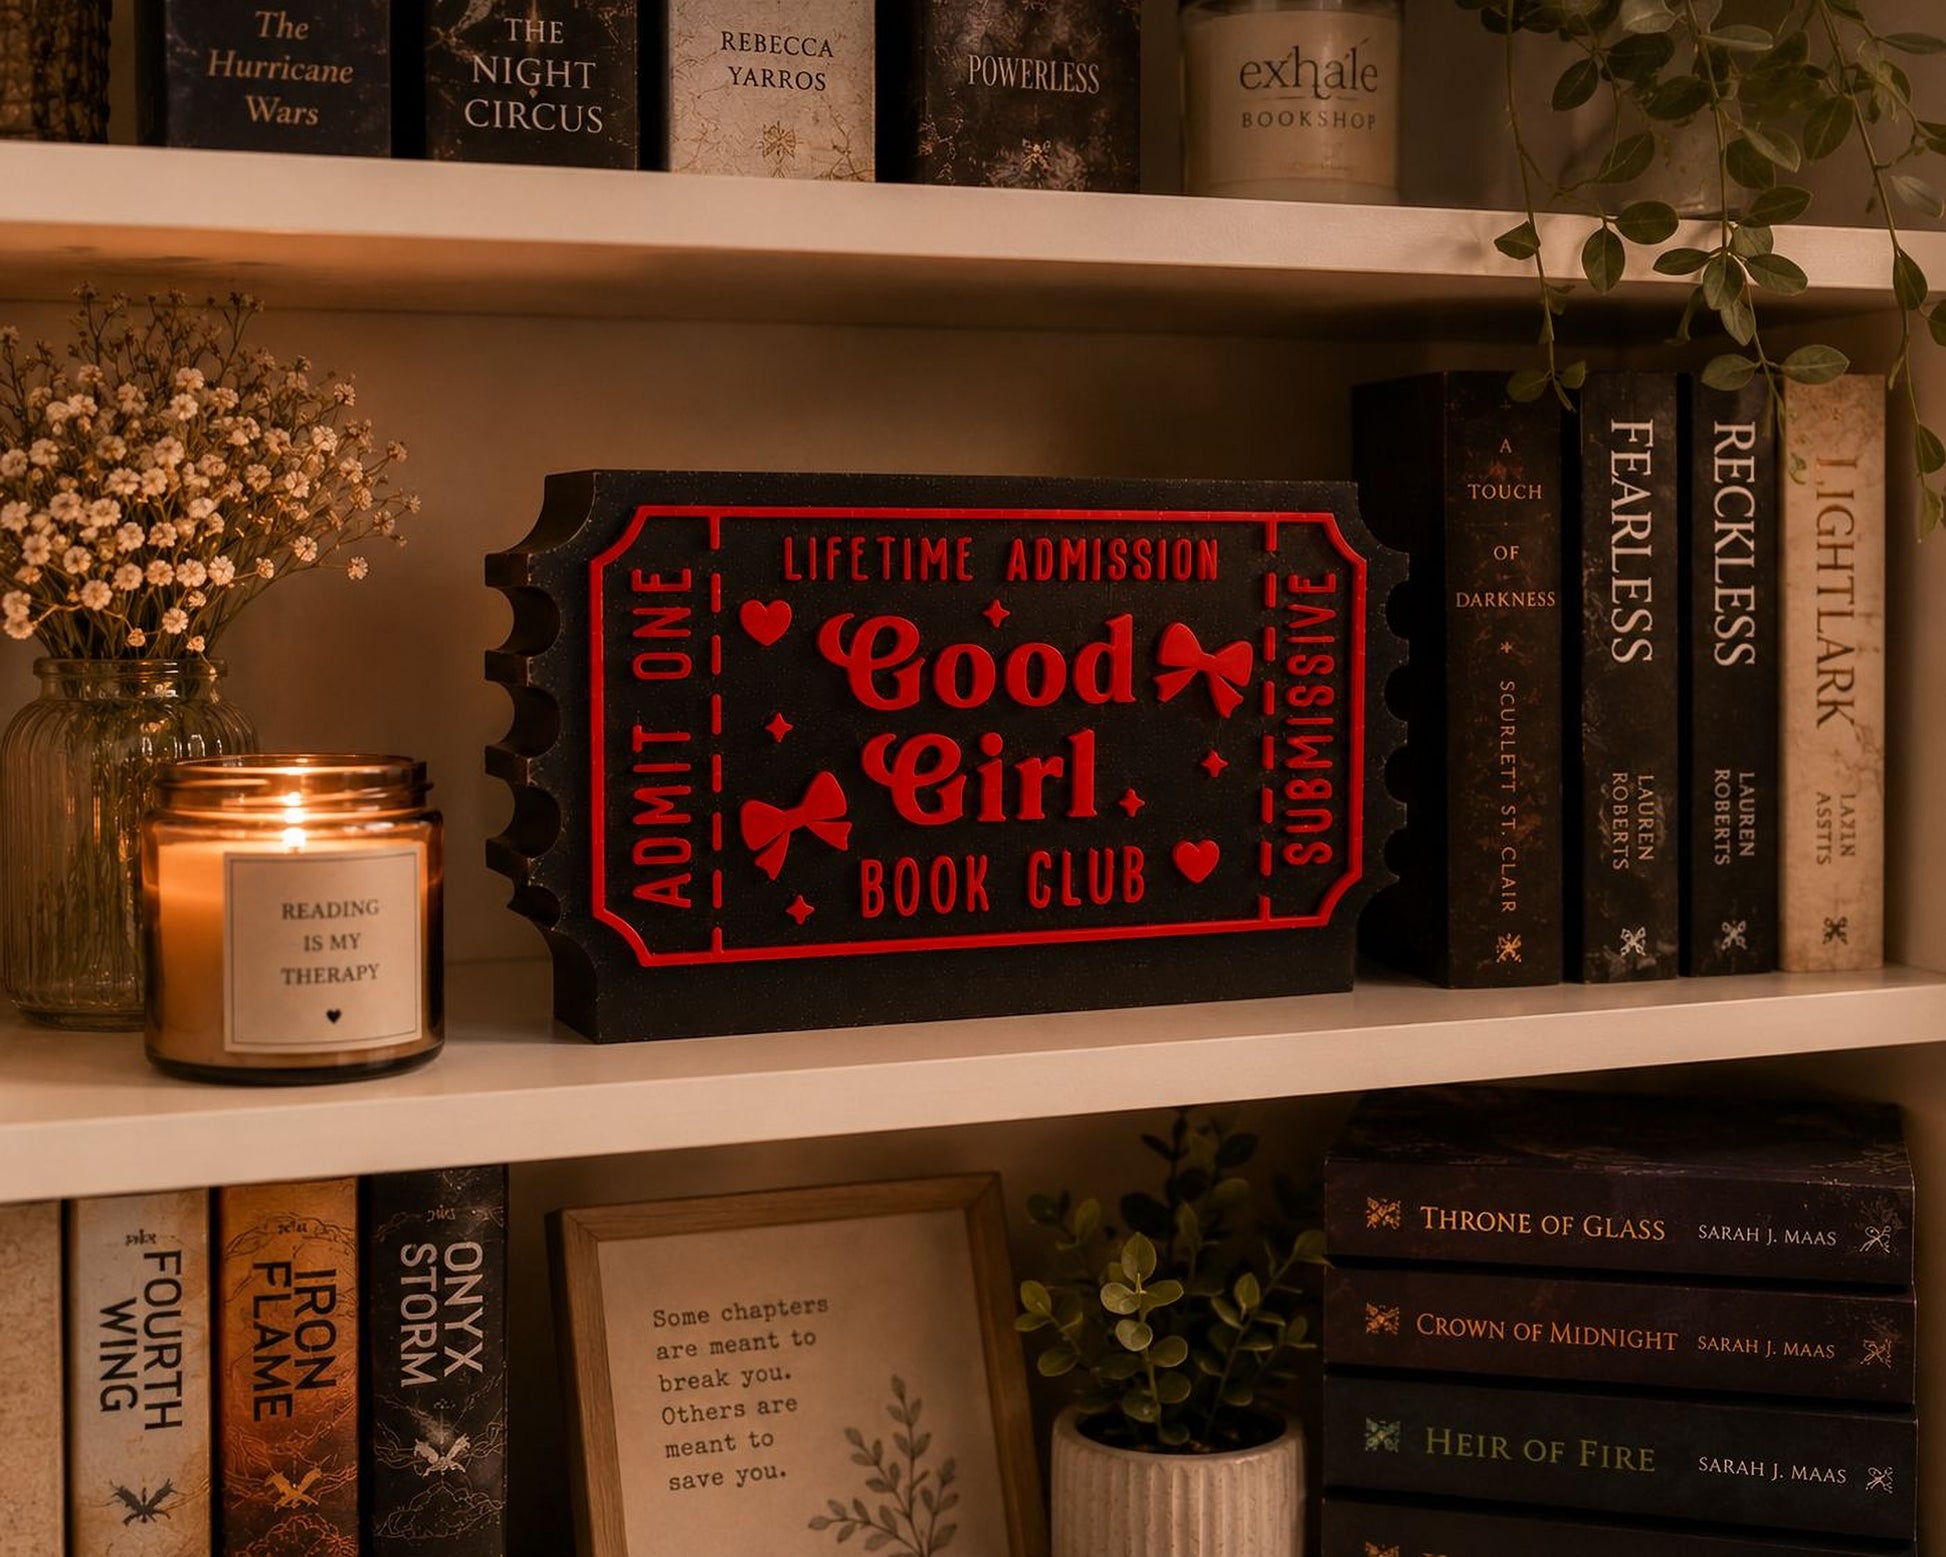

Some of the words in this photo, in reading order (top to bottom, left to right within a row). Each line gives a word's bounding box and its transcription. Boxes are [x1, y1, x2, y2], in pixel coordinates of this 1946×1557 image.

[255, 10, 309, 40] The
[503, 18, 564, 45] THE
[720, 31, 834, 58] REBECCA
[207, 49, 354, 85] Hurricane
[472, 54, 597, 90] NIGHT
[727, 65, 828, 92] YARROS
[968, 54, 1100, 95] POWERLESS
[246, 95, 319, 126] Wars
[464, 99, 603, 135] CIRCUS
[1242, 110, 1376, 130] BOOKSHOP
[1500, 438, 1512, 454] A
[1467, 484, 1543, 501] TOUCH
[784, 536, 974, 581] LIFETIME
[1006, 538, 1220, 582] ADMISSION
[1494, 545, 1520, 562] OF
[1611, 419, 1654, 665] FEARLESS
[1714, 420, 1756, 668] RECKLESS
[1456, 592, 1556, 608] DARKNESS
[632, 567, 692, 681] ONE
[817, 612, 1137, 711] Good
[1282, 572, 1337, 866] SUBMISSIVE
[861, 728, 1097, 826] Girl
[632, 724, 692, 908] ADMIT
[1501, 805, 1516, 836] ST.
[1612, 772, 1629, 871] ROBERTS
[1638, 774, 1654, 862] LAUREN
[1714, 769, 1731, 867] ROBERTS
[1739, 772, 1755, 858] LAUREN
[861, 853, 990, 918] BOOK
[1028, 846, 1146, 909] CLUB
[1501, 846, 1516, 912] CLAIR
[281, 899, 380, 921] READING
[303, 935, 323, 952] IS
[330, 932, 362, 951] MY
[280, 963, 380, 987] THERAPY
[1420, 1206, 1533, 1235] THRONE
[1542, 1214, 1575, 1236] OF
[1583, 1215, 1666, 1242] GLASS
[1698, 1224, 1759, 1243] SARAH
[1766, 1228, 1778, 1246] J.
[1785, 1231, 1838, 1247] MAAS
[400, 1243, 438, 1386] STORM
[443, 1240, 484, 1377] ONYX
[653, 1309, 710, 1328] Some
[721, 1299, 829, 1322] chapters
[143, 1250, 184, 1431] FOURTH
[252, 1261, 293, 1422] FLAME
[294, 1268, 338, 1392] IRON
[656, 1344, 697, 1360] are
[709, 1332, 780, 1355] meant
[791, 1331, 816, 1347] to
[1416, 1313, 1505, 1341] CROWN
[1513, 1321, 1544, 1343] OF
[1550, 1322, 1679, 1353] MIDNIGHT
[1698, 1335, 1759, 1354] SARAH
[1766, 1341, 1778, 1358] J.
[1784, 1342, 1836, 1359] MAAS
[100, 1297, 138, 1412] WING
[658, 1369, 730, 1393] break
[741, 1367, 792, 1388] you.
[661, 1403, 745, 1425] Others
[757, 1397, 798, 1415] are
[665, 1434, 737, 1458] meant
[749, 1431, 774, 1447] to
[1425, 1426, 1512, 1461] HEIR
[1523, 1437, 1565, 1464] OF
[1578, 1440, 1657, 1472] FIRE
[669, 1471, 724, 1491] save
[736, 1465, 787, 1488] you.
[1698, 1456, 1765, 1477] SARAH
[1772, 1463, 1784, 1481] J.
[1791, 1466, 1848, 1484] MAAS
